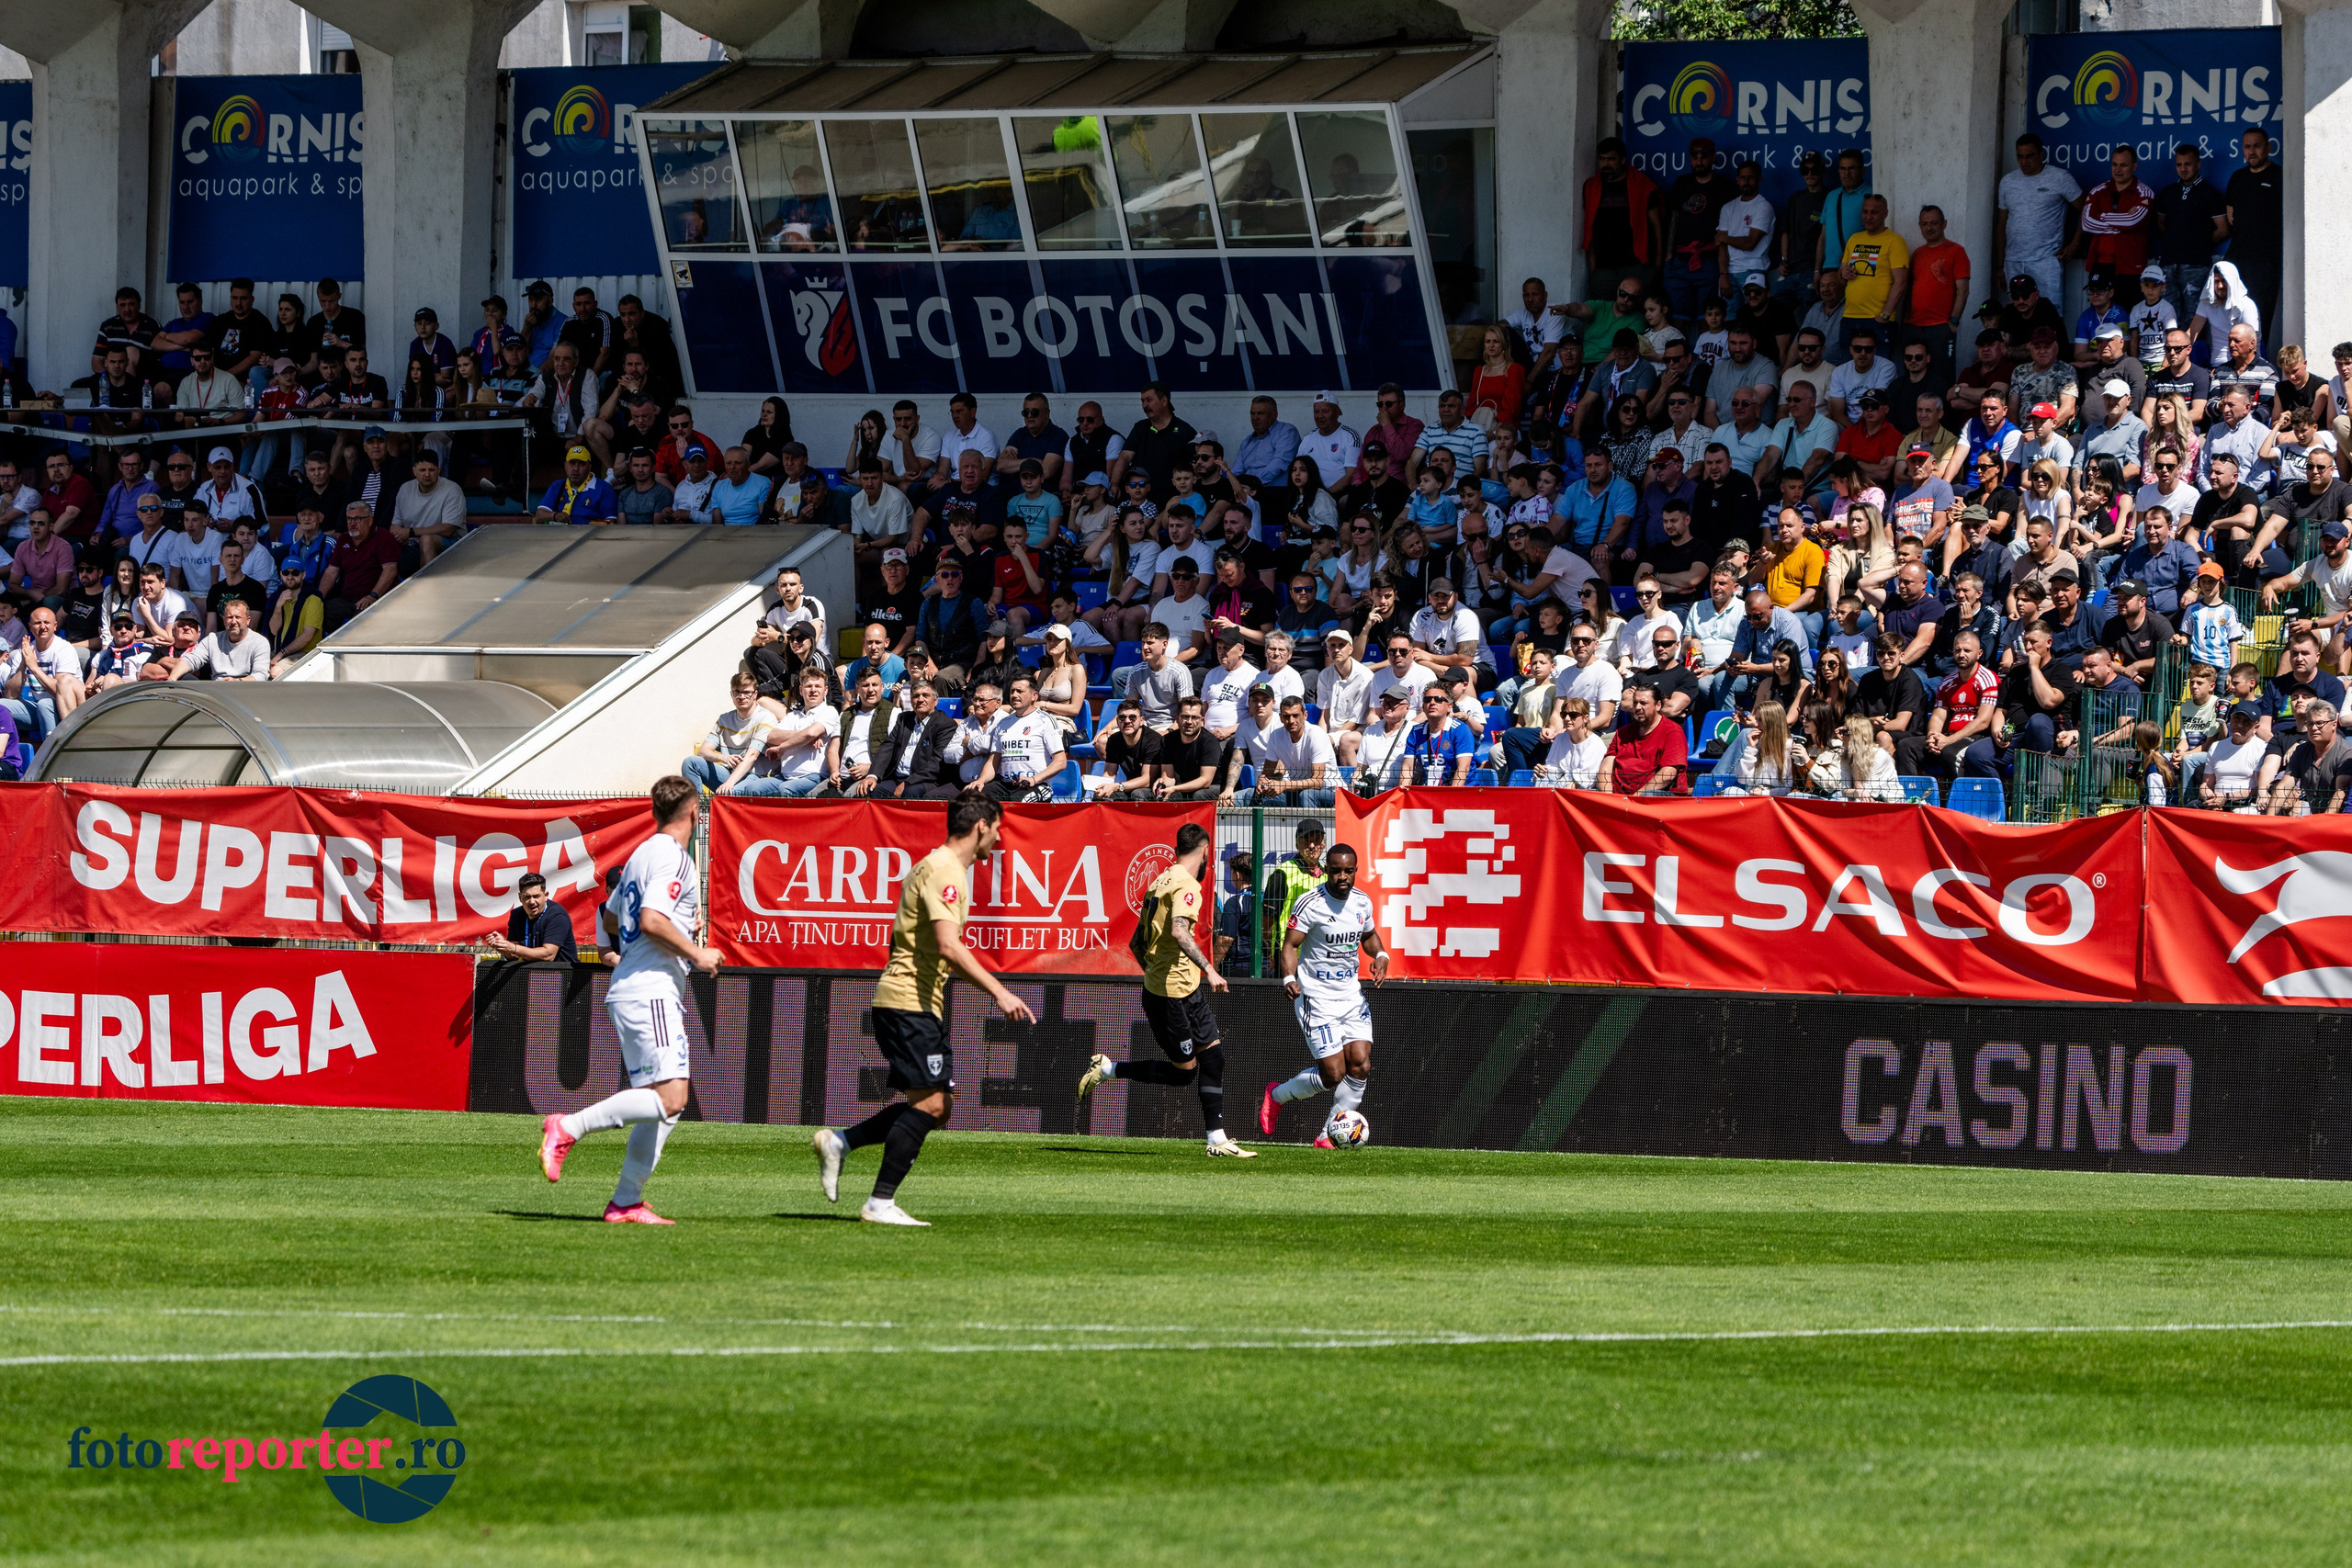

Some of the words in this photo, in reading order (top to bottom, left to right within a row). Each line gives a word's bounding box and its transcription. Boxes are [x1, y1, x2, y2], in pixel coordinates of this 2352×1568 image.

[663, 163, 677, 185] &
[2199, 135, 2214, 158] &
[179, 173, 299, 201] aquapark
[311, 173, 325, 195] &
[873, 295, 962, 359] FC
[973, 291, 1347, 373] BOTOȘANI
[2203, 626, 2217, 639] 10
[69, 800, 599, 925] SUPERLIGA
[739, 840, 1110, 922] CARPTINA
[1581, 851, 2096, 946] ELSACO
[736, 920, 783, 944] APA
[966, 926, 1051, 951] SUFLET
[1057, 927, 1110, 951] BUN
[0, 970, 378, 1088] ERLIGA
[1317, 1024, 1333, 1044] 11
[1840, 1038, 2194, 1155] CASINO
